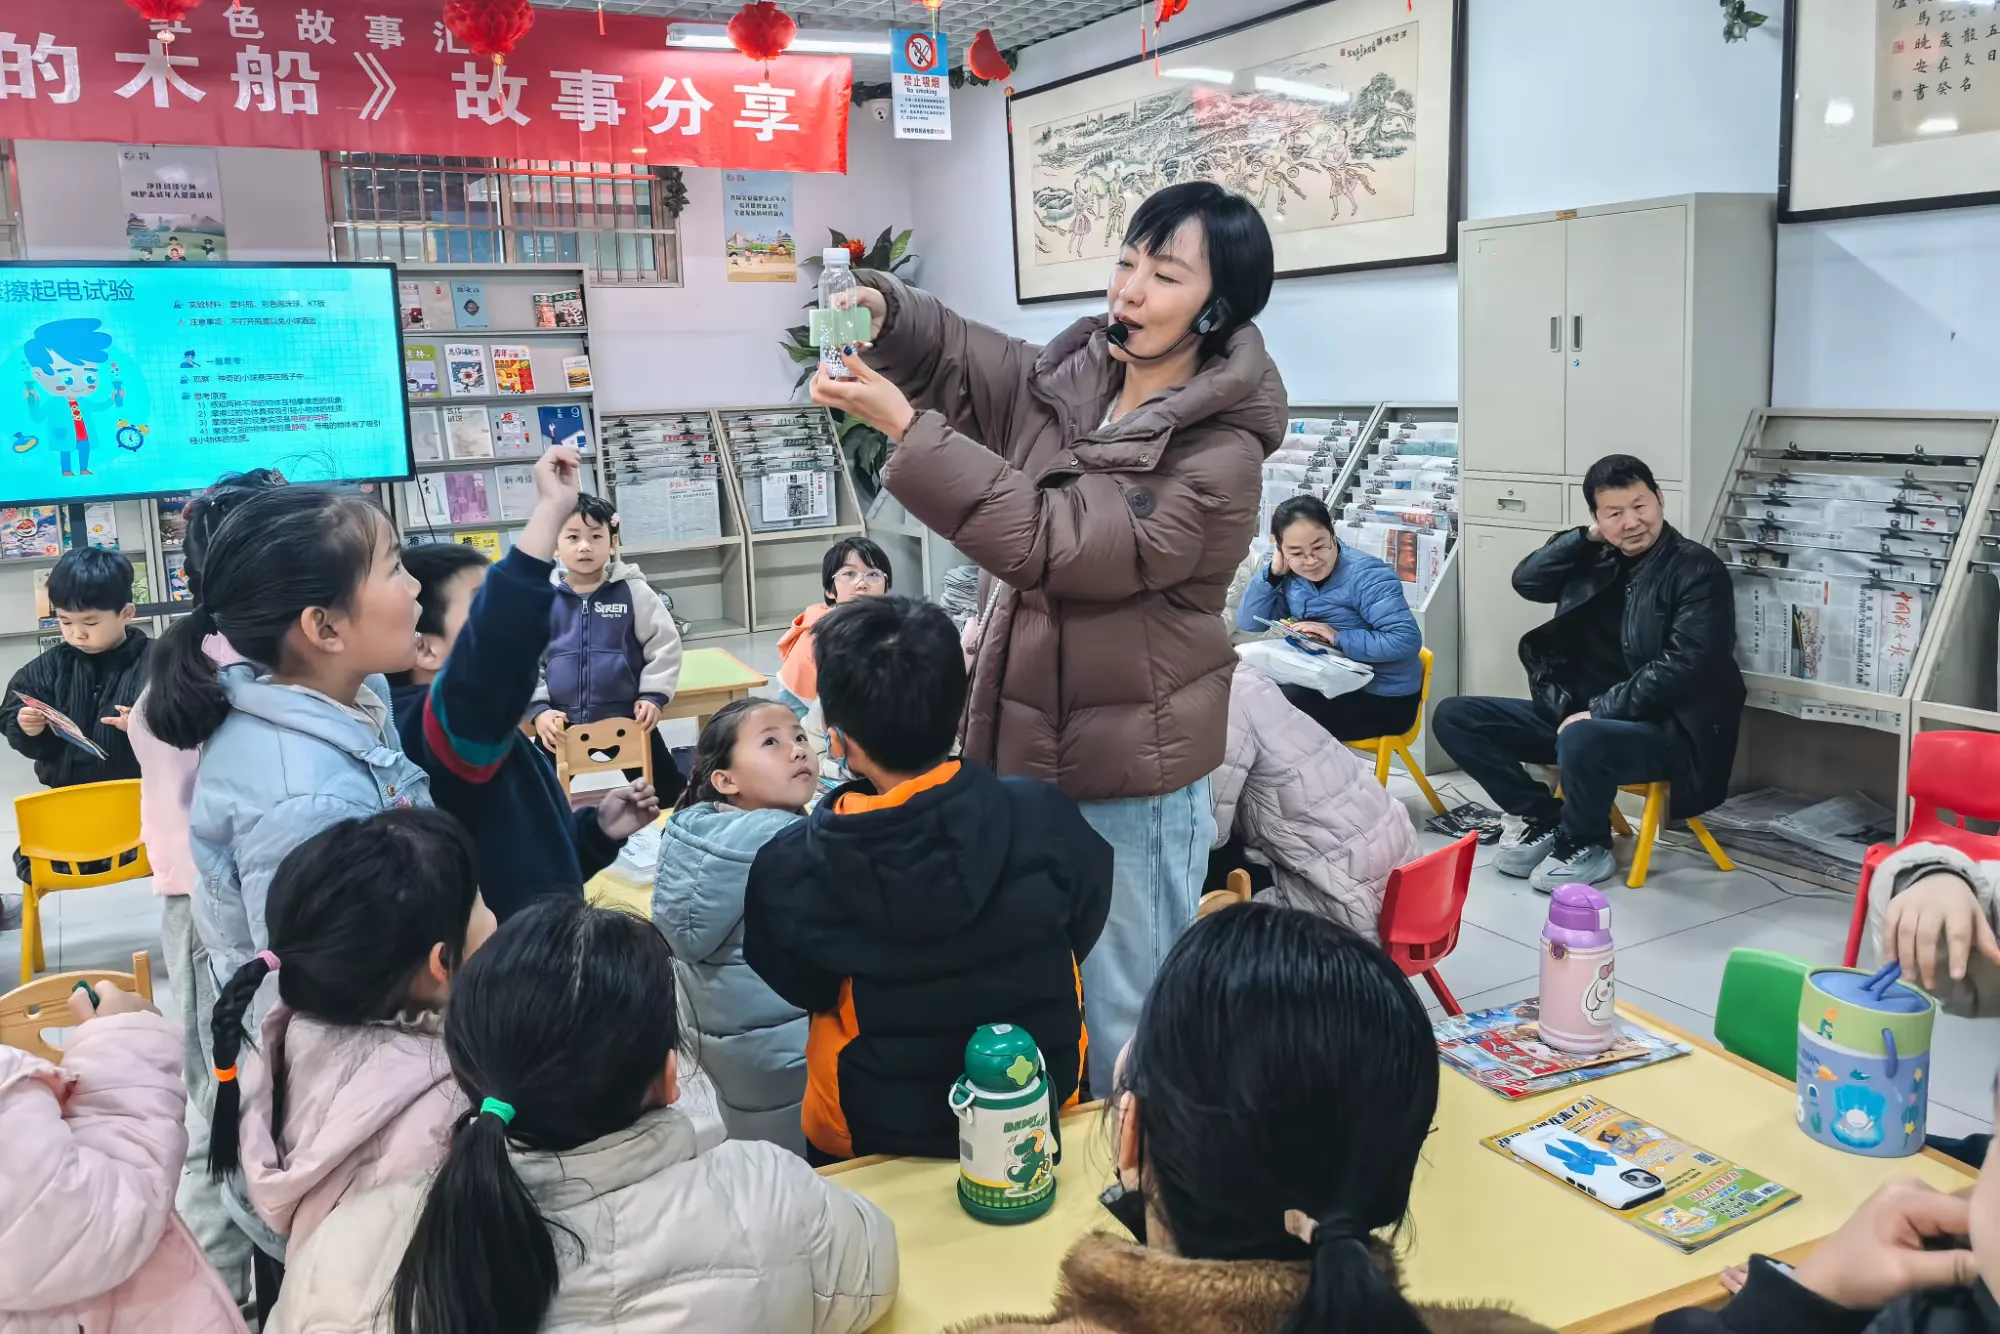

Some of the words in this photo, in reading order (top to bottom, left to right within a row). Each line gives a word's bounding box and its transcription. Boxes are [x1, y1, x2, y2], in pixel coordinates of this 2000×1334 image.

[1912, 0, 1932, 101] 馬曉安書
[903, 75, 940, 89] 禁止吸烟
[906, 87, 914, 95] No
[916, 88, 938, 97] smoking
[0, 278, 136, 302] 擦起电试验
[570, 407, 580, 418] 9
